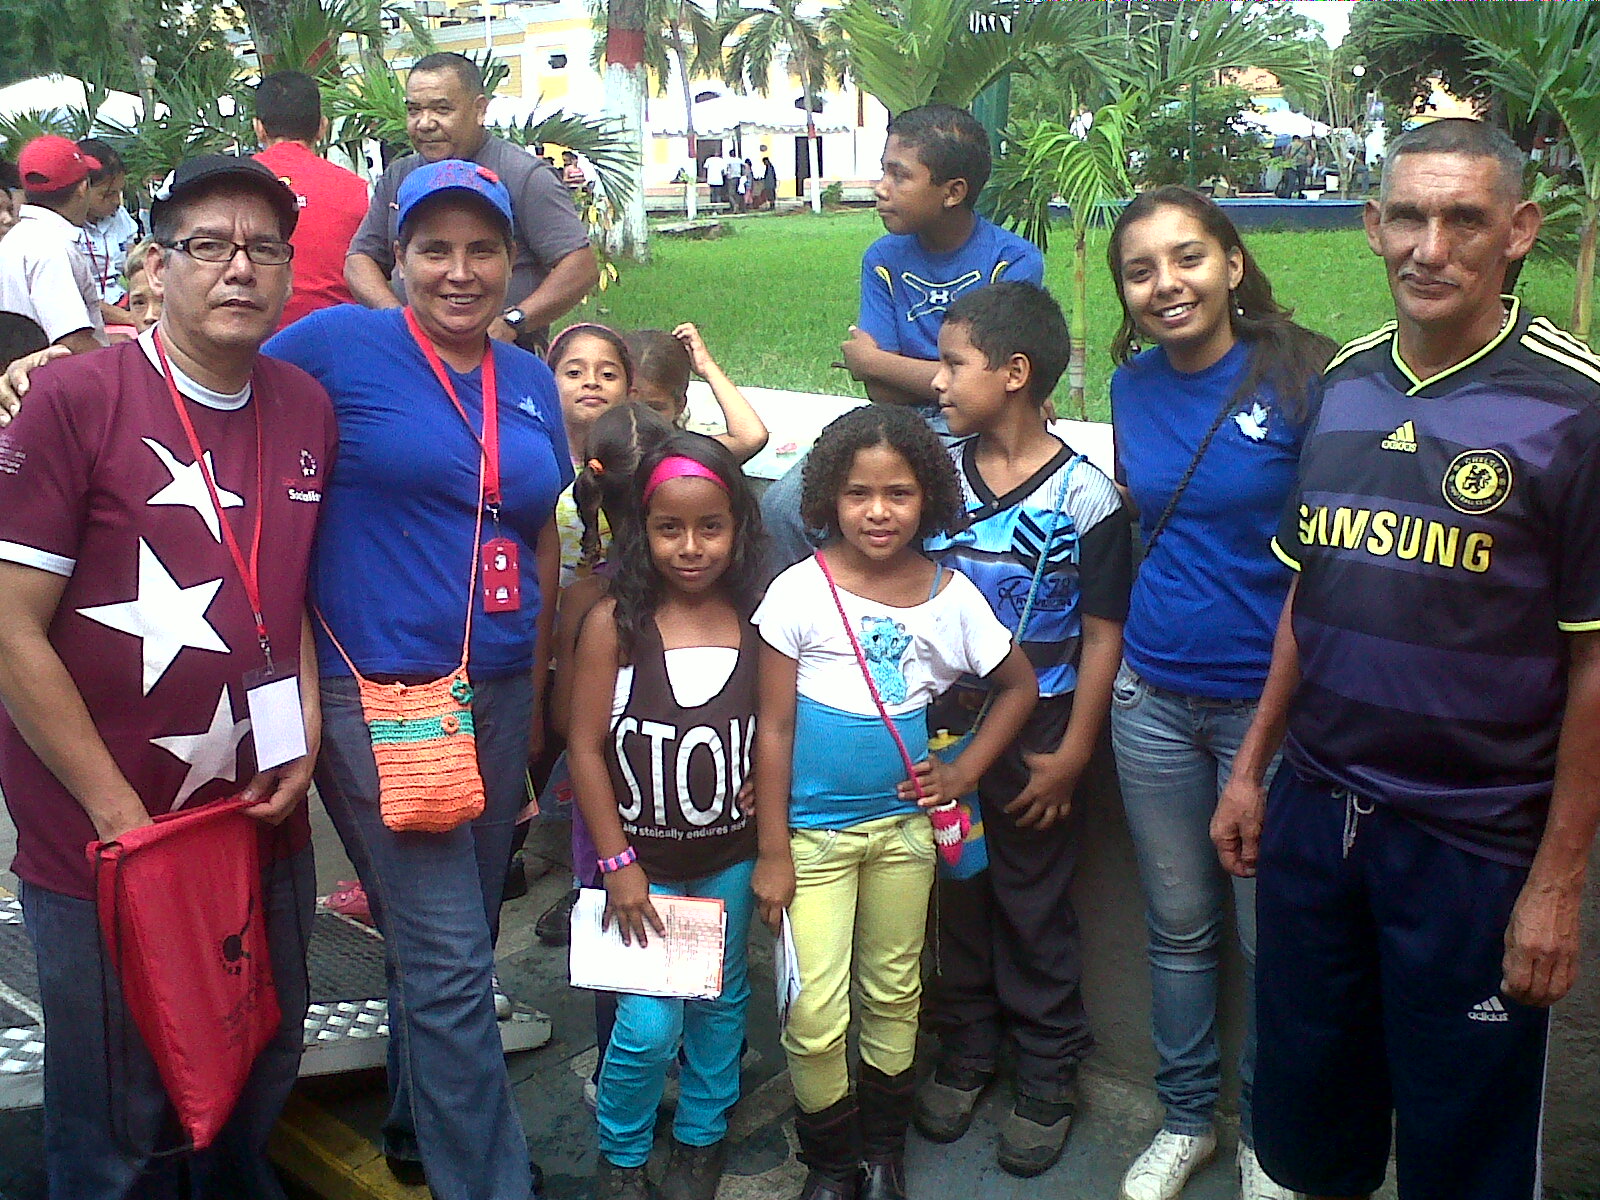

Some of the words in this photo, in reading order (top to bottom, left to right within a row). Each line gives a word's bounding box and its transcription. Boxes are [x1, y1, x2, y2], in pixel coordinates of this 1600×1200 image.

[638, 826, 685, 841] stoically
[686, 825, 729, 839] endures
[1467, 1011, 1509, 1021] adidas
